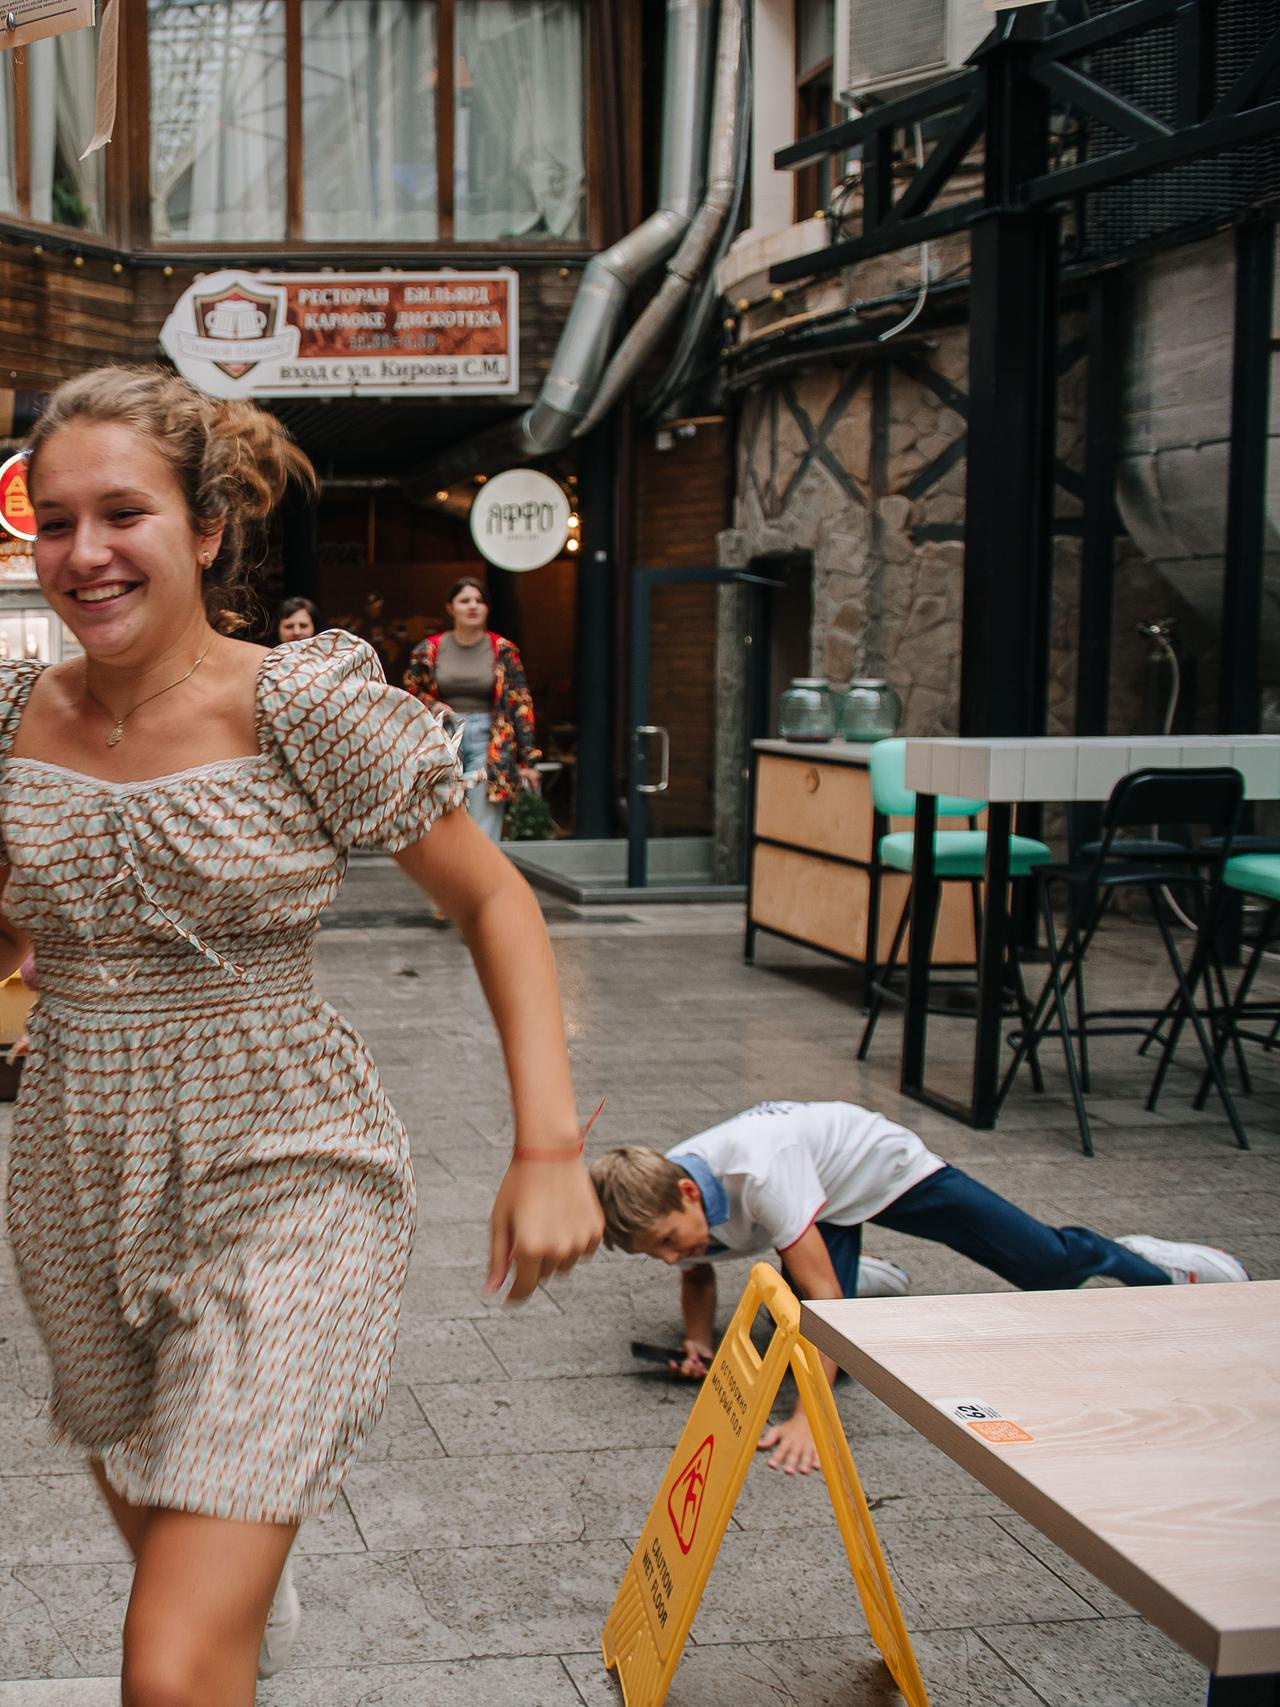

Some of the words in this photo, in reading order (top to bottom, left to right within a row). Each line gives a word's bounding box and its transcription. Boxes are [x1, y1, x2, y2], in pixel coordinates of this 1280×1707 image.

[298, 287, 389, 305] РЕСТОРАН
[404, 286, 489, 305] БИЛЬЯРД
[304, 312, 387, 330] КАРАОКЕ
[394, 310, 502, 329] ДИСКОТЕКА
[280, 365, 327, 380] вход
[331, 364, 341, 377] с
[380, 361, 458, 380] Кирова
[652, 1537, 673, 1600] CAUTION
[642, 1548, 654, 1581] WET
[651, 1579, 668, 1631] FLOOR
